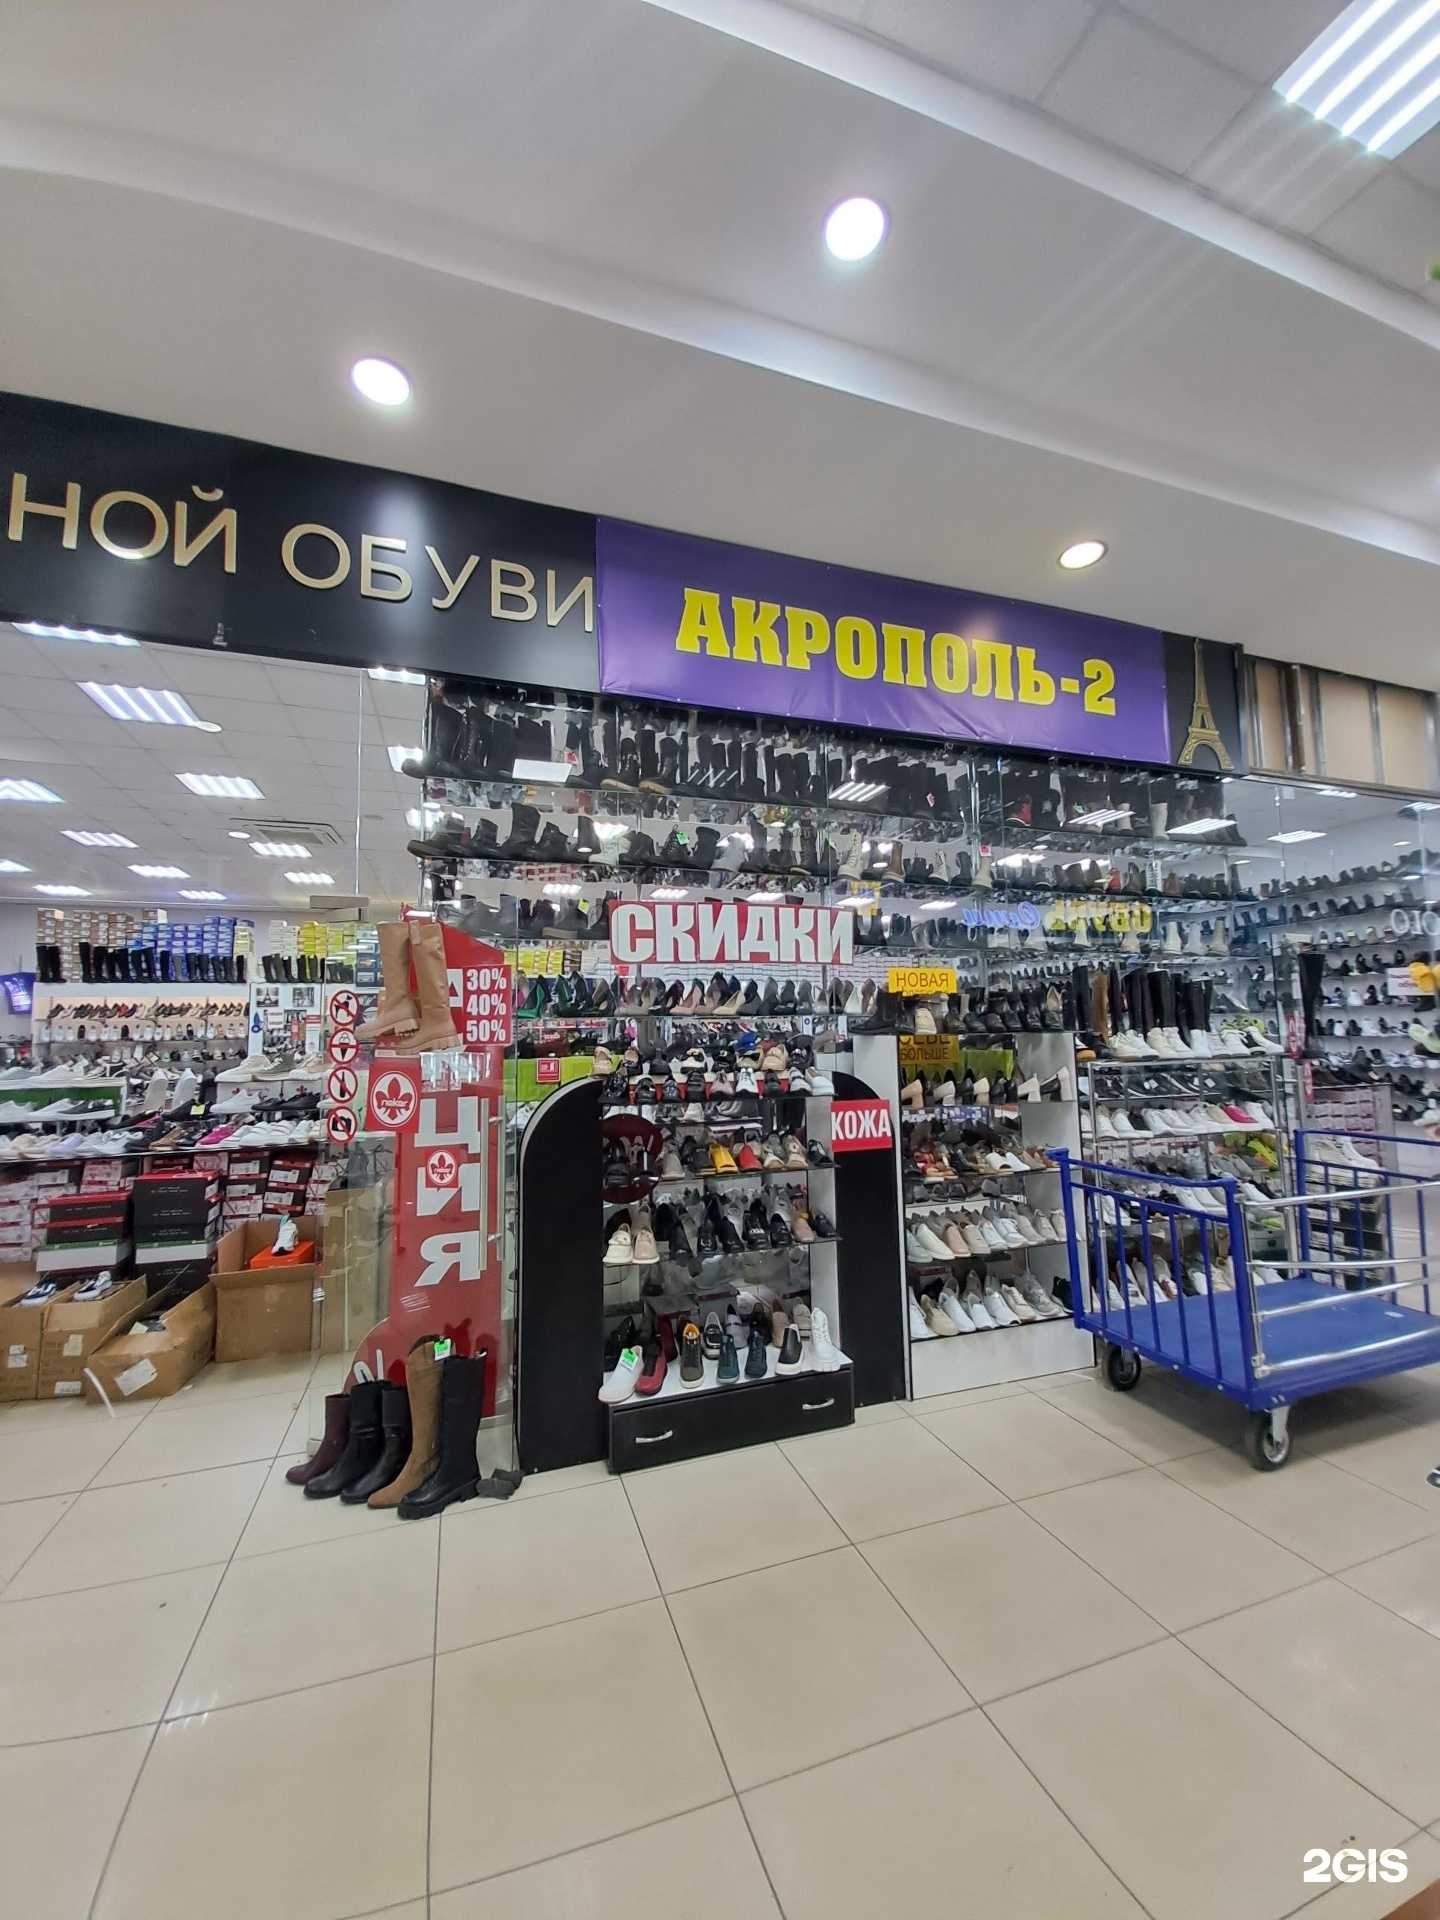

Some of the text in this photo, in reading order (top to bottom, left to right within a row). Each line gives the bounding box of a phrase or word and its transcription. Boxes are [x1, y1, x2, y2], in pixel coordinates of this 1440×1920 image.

[8, 472, 594, 632] НОЙ ОБУВИ
[674, 587, 1116, 716] АКРОПОЛЬ-2
[611, 902, 853, 963] СКИДКИ
[466, 967, 507, 991] 30%
[896, 972, 949, 987] НОВАЯ
[466, 993, 506, 1016] 40%
[466, 1019, 506, 1042] 50%
[831, 1108, 891, 1141] КОЖА
